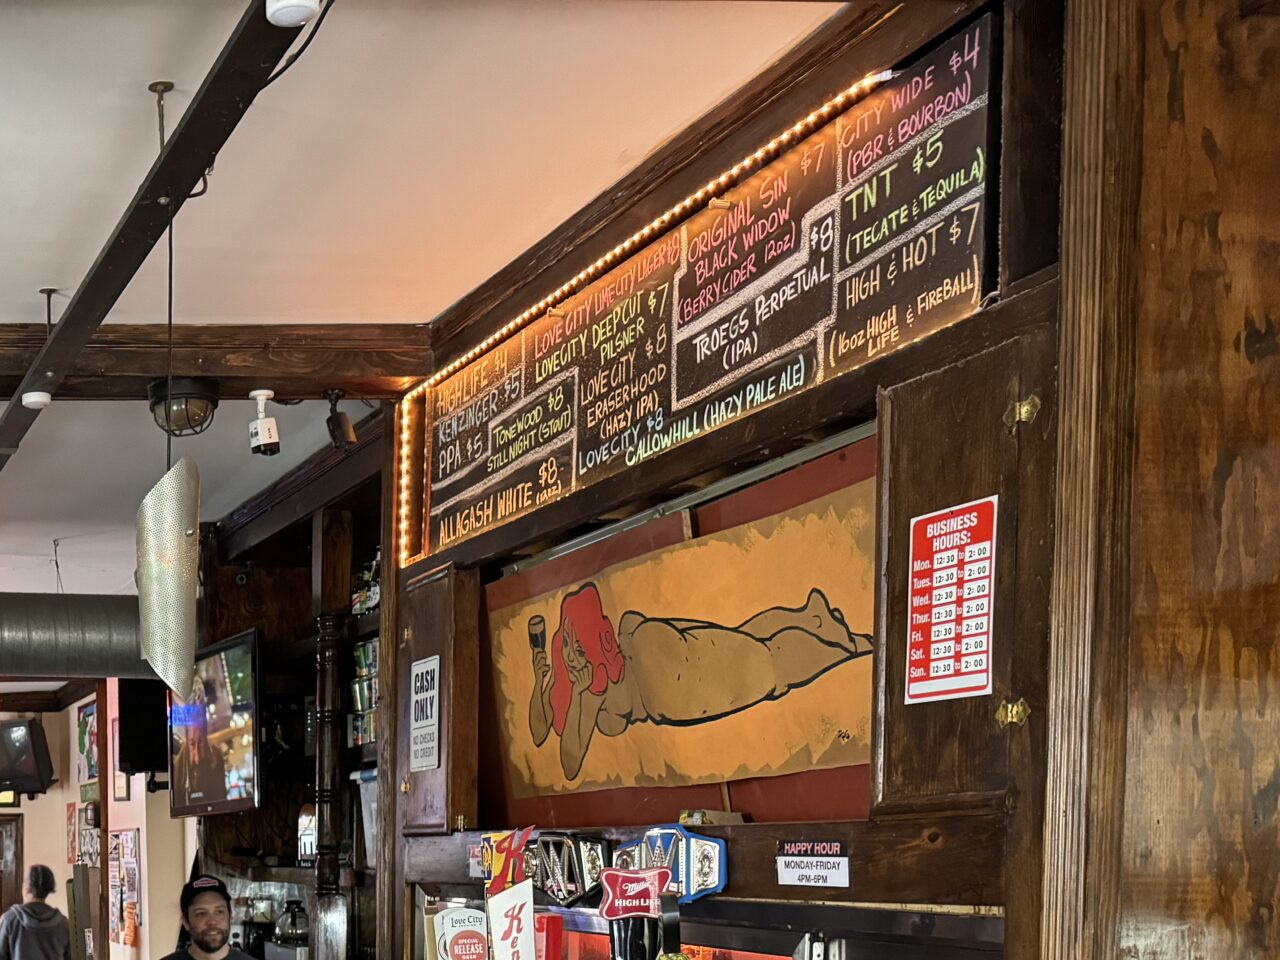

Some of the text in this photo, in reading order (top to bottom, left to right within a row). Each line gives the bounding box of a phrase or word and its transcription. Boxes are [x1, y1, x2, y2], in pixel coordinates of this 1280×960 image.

[842, 27, 981, 148] CITY WIDE $4
[847, 134, 883, 182] (PBR
[897, 70, 971, 143] BOURBON)
[845, 129, 944, 221] TNT $5
[687, 142, 825, 263] ORIGINAL SIN $7
[846, 204, 908, 264] (TECATE
[919, 146, 986, 211] TEQUILA)
[695, 197, 791, 286] BLACK WIDOW
[846, 264, 880, 310] HIGH
[902, 221, 945, 272] HOT
[949, 202, 980, 245] $7
[648, 282, 669, 318] $7
[692, 216, 834, 363] TROEGS PERPETUAL $8
[866, 305, 897, 339] HIGH
[918, 254, 980, 315] FIREBALL)
[535, 323, 563, 359] LOVE
[566, 295, 592, 335] CITY
[600, 316, 645, 366] PILSNER
[868, 326, 900, 357] LIFE
[495, 349, 508, 378] $4
[581, 323, 667, 407] LOVE CITY $8
[723, 331, 758, 370] (IPA)
[439, 371, 520, 446] KENZINGER $5
[548, 386, 564, 416] $8
[587, 363, 666, 428] ERASERHOOD
[625, 353, 805, 467] CALLOWHILL (HAZY PALE ALE)
[538, 405, 571, 442] (STOUT)
[600, 390, 659, 440] (HAZY IPA)
[646, 408, 663, 432] $8
[439, 433, 483, 478] PPA $5
[439, 457, 558, 546] ALLAGASH WHITE $8
[927, 512, 978, 538] BUSINESS
[933, 531, 971, 552] HOURS:
[914, 560, 931, 572] Mon.
[959, 550, 964, 559] to
[913, 578, 932, 589] Tues.
[958, 569, 964, 578] to
[913, 596, 930, 607] Wed.
[957, 588, 963, 596] to
[912, 614, 930, 626] Thur.
[956, 606, 962, 614] to
[912, 631, 923, 643] Fri.
[956, 624, 961, 633] to
[911, 649, 925, 661] Sat.
[955, 642, 961, 651] to
[414, 668, 435, 695] CASH
[910, 666, 926, 679] Sun.
[954, 661, 960, 670] to
[414, 695, 434, 723] ONLY
[784, 842, 840, 854] HAPPY HOUR
[784, 860, 841, 870] MONDAY-FRIDAY
[797, 875, 827, 883] 4PM-6PM
[615, 898, 639, 907] HIGH
[451, 917, 466, 928] Love
[467, 915, 483, 925] City
[454, 944, 484, 955] RELEASE
